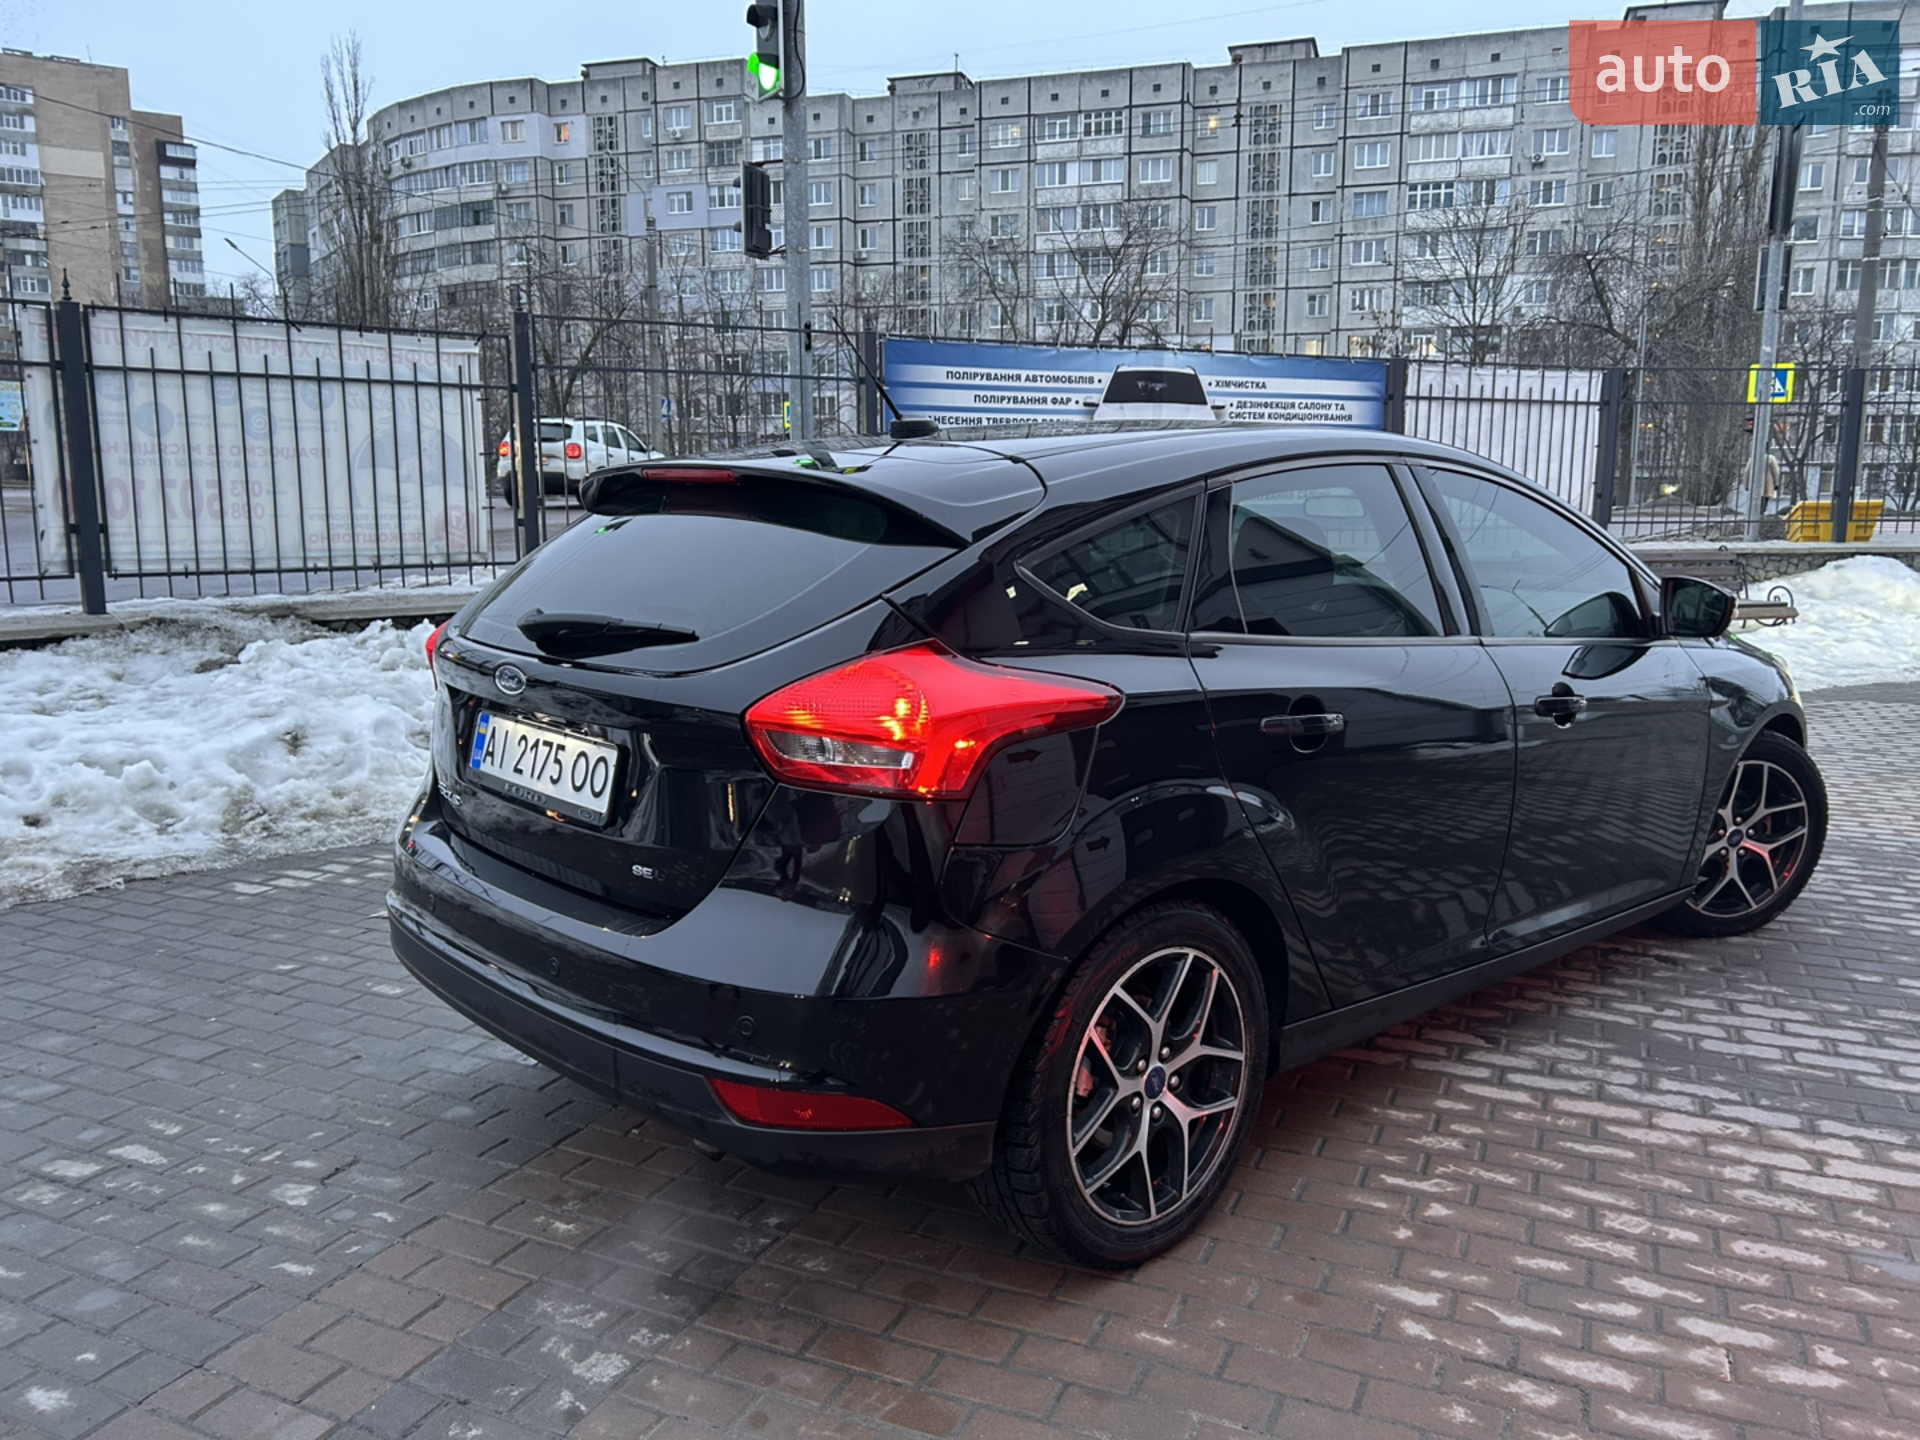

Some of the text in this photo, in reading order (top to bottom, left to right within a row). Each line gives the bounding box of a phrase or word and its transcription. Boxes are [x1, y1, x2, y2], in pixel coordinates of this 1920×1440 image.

[946, 370, 1095, 385] ПОЛІРУВАННЯ АВТОМОБІЛІВ
[1214, 379, 1267, 390] ХІМЧИСТКА
[974, 394, 1072, 405] ПОЛІРУВАННЯ ФАР
[1235, 400, 1346, 411] ДЕЗІНФЕКЦІЯ САЛОНУ ТА
[1228, 411, 1353, 422] СИСТЕМ КОНДИЦІОНУВАННЯ
[482, 726, 609, 799] AI 2175 OO
[504, 782, 547, 806] FORD
